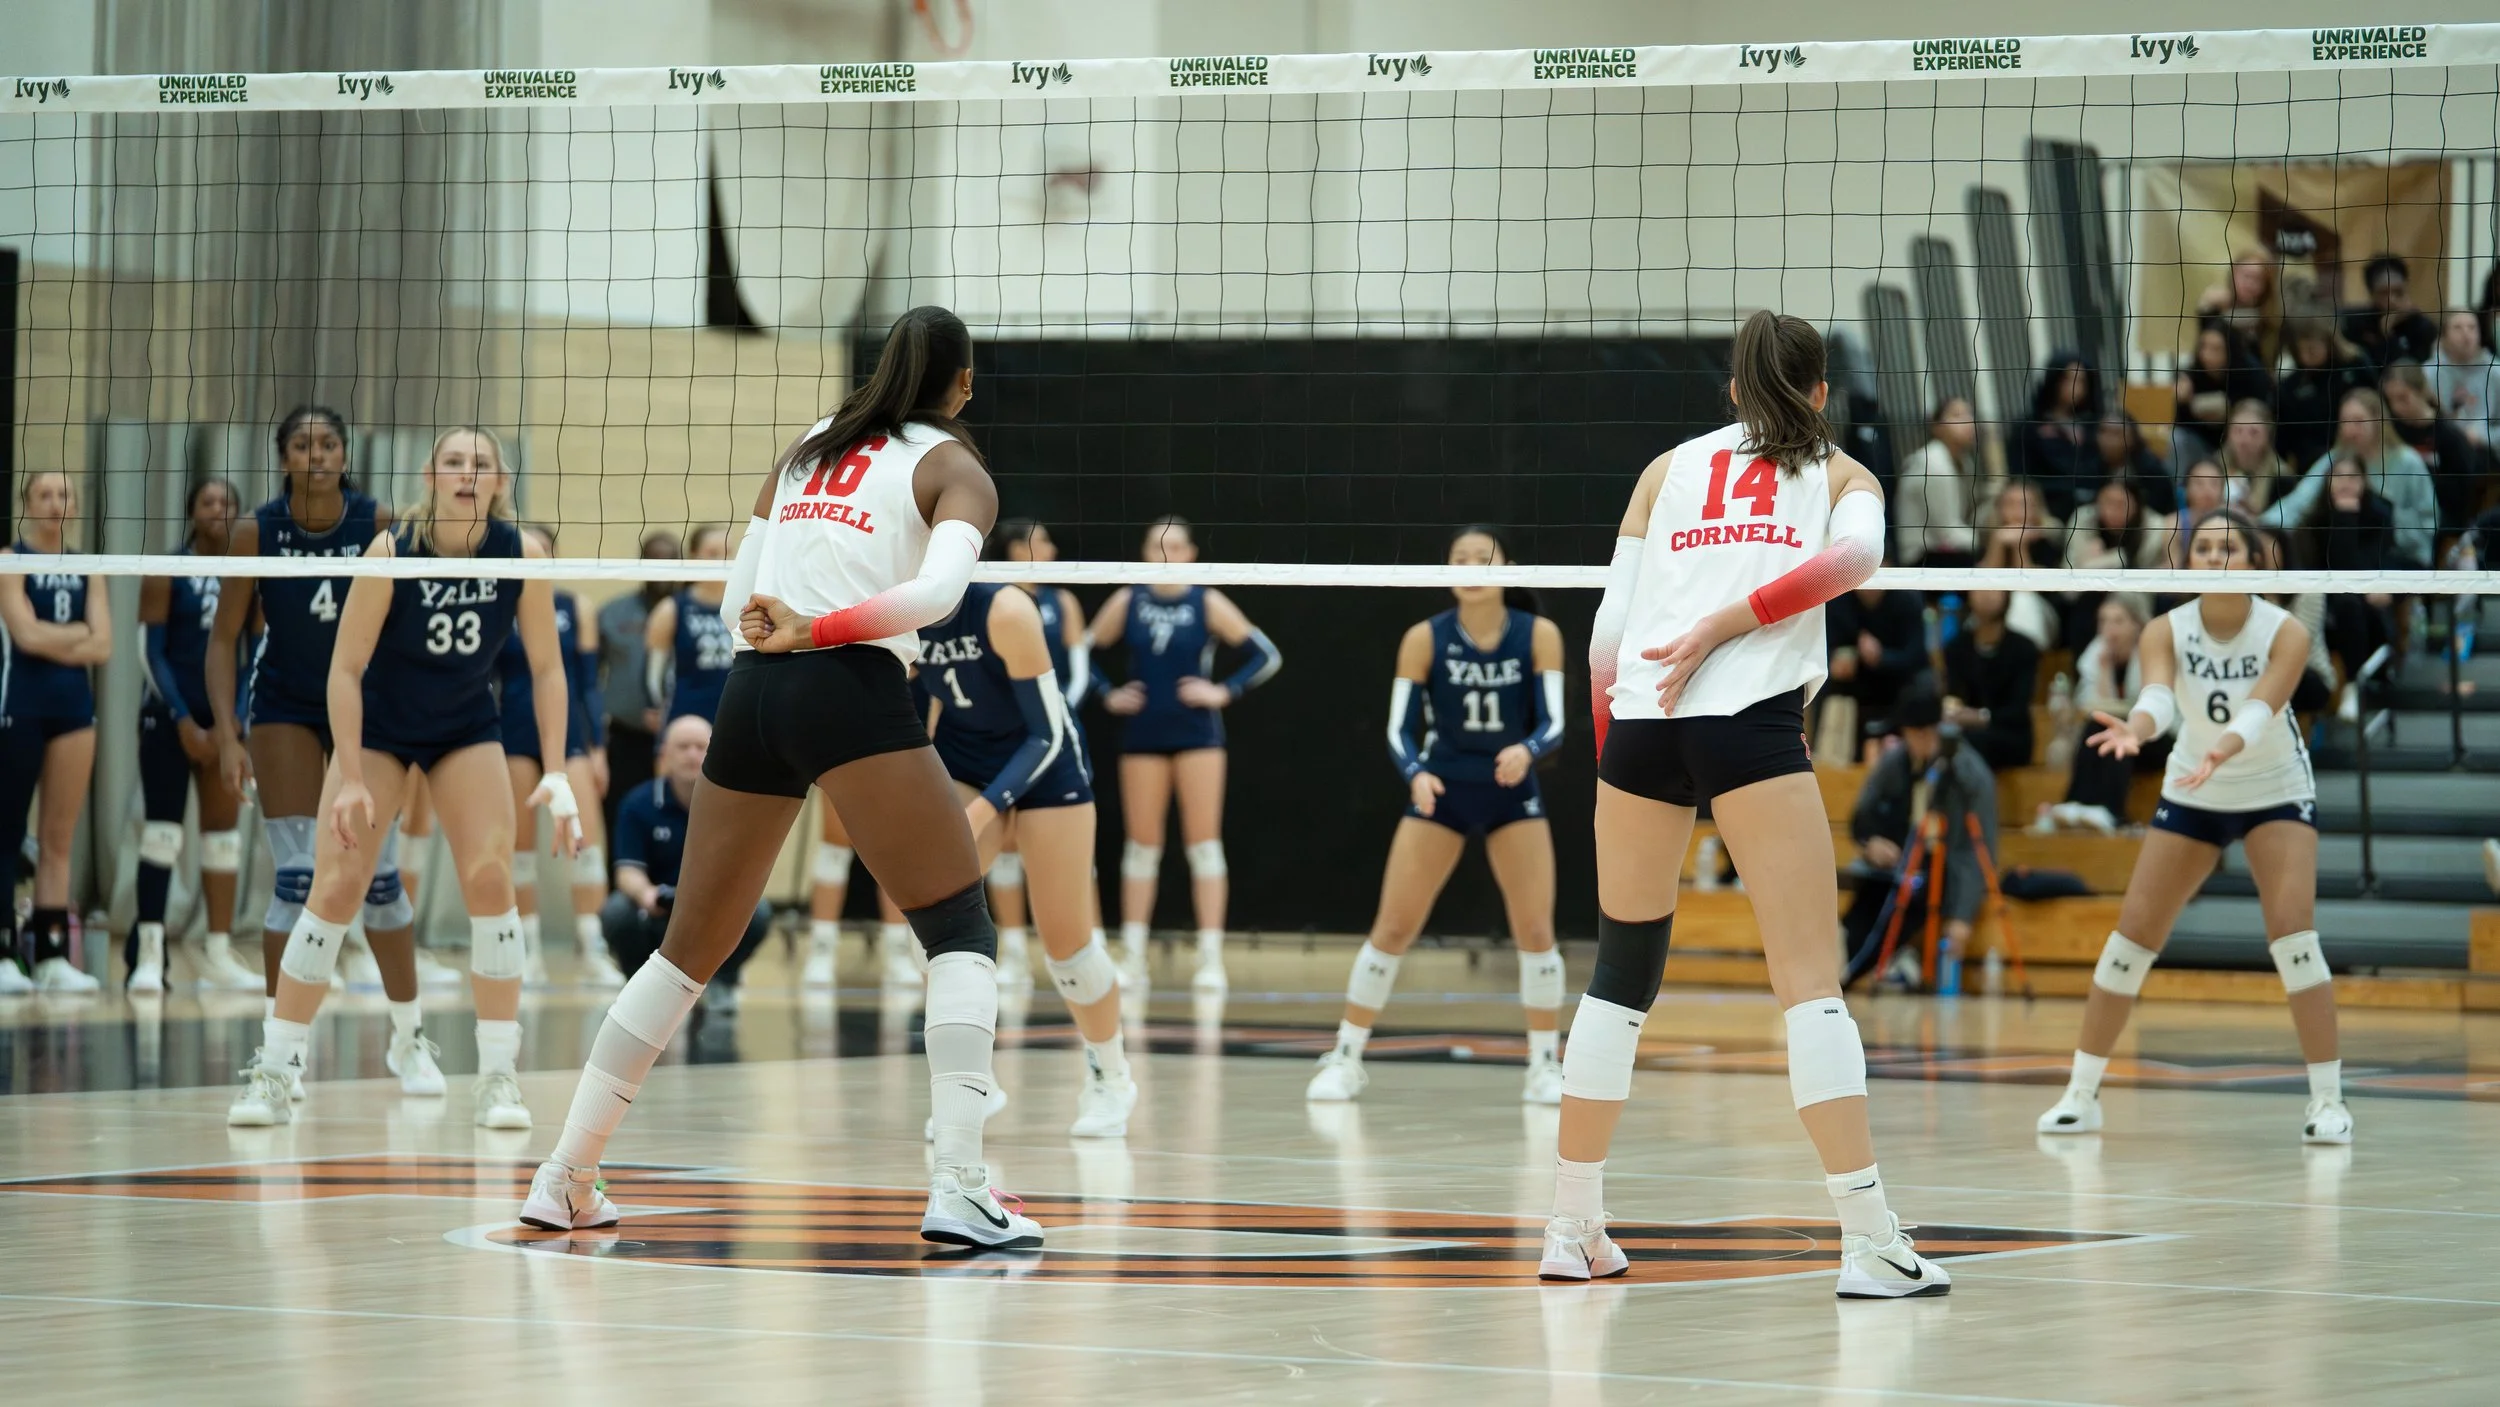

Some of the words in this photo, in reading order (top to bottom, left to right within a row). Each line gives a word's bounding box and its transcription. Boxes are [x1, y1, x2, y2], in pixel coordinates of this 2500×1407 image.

[1913, 39, 2020, 55] UNRIVALED
[2130, 35, 2174, 64] Ivy
[2312, 27, 2426, 45] UNRIVALED
[1170, 57, 1268, 72] UNRIVALED
[1534, 49, 1635, 64] UNRIVALED
[1739, 45, 1781, 73] Ivy
[1913, 55, 2021, 71] EXPERIENCE
[2313, 43, 2427, 60] EXPERIENCE
[484, 71, 575, 84] UNRIVALED
[820, 64, 914, 79] UNRIVALED
[1012, 62, 1049, 90] Ivy
[1170, 72, 1269, 87] EXPERIENCE
[1368, 54, 1407, 82] Ivy
[1534, 64, 1636, 79] EXPERIENCE
[15, 78, 49, 103] Ivy
[159, 75, 246, 89] UNRIVALED
[338, 74, 373, 101] Ivy
[485, 85, 577, 99] EXPERIENCE
[669, 69, 704, 95] Ivy
[820, 79, 916, 94] EXPERIENCE
[159, 90, 248, 104] EXPERIENCE
[802, 435, 888, 497] 16
[1701, 449, 1778, 521] 14
[779, 502, 875, 534] CORNELL
[1671, 523, 1803, 552] CORNELL
[310, 579, 337, 622] 4
[419, 577, 498, 608] YALE
[426, 610, 482, 656] 33
[1445, 658, 1522, 687] YALE
[2186, 651, 2259, 681] YALE
[943, 667, 973, 708] 1
[1463, 690, 1505, 732] 11
[2207, 690, 2231, 724] 6
